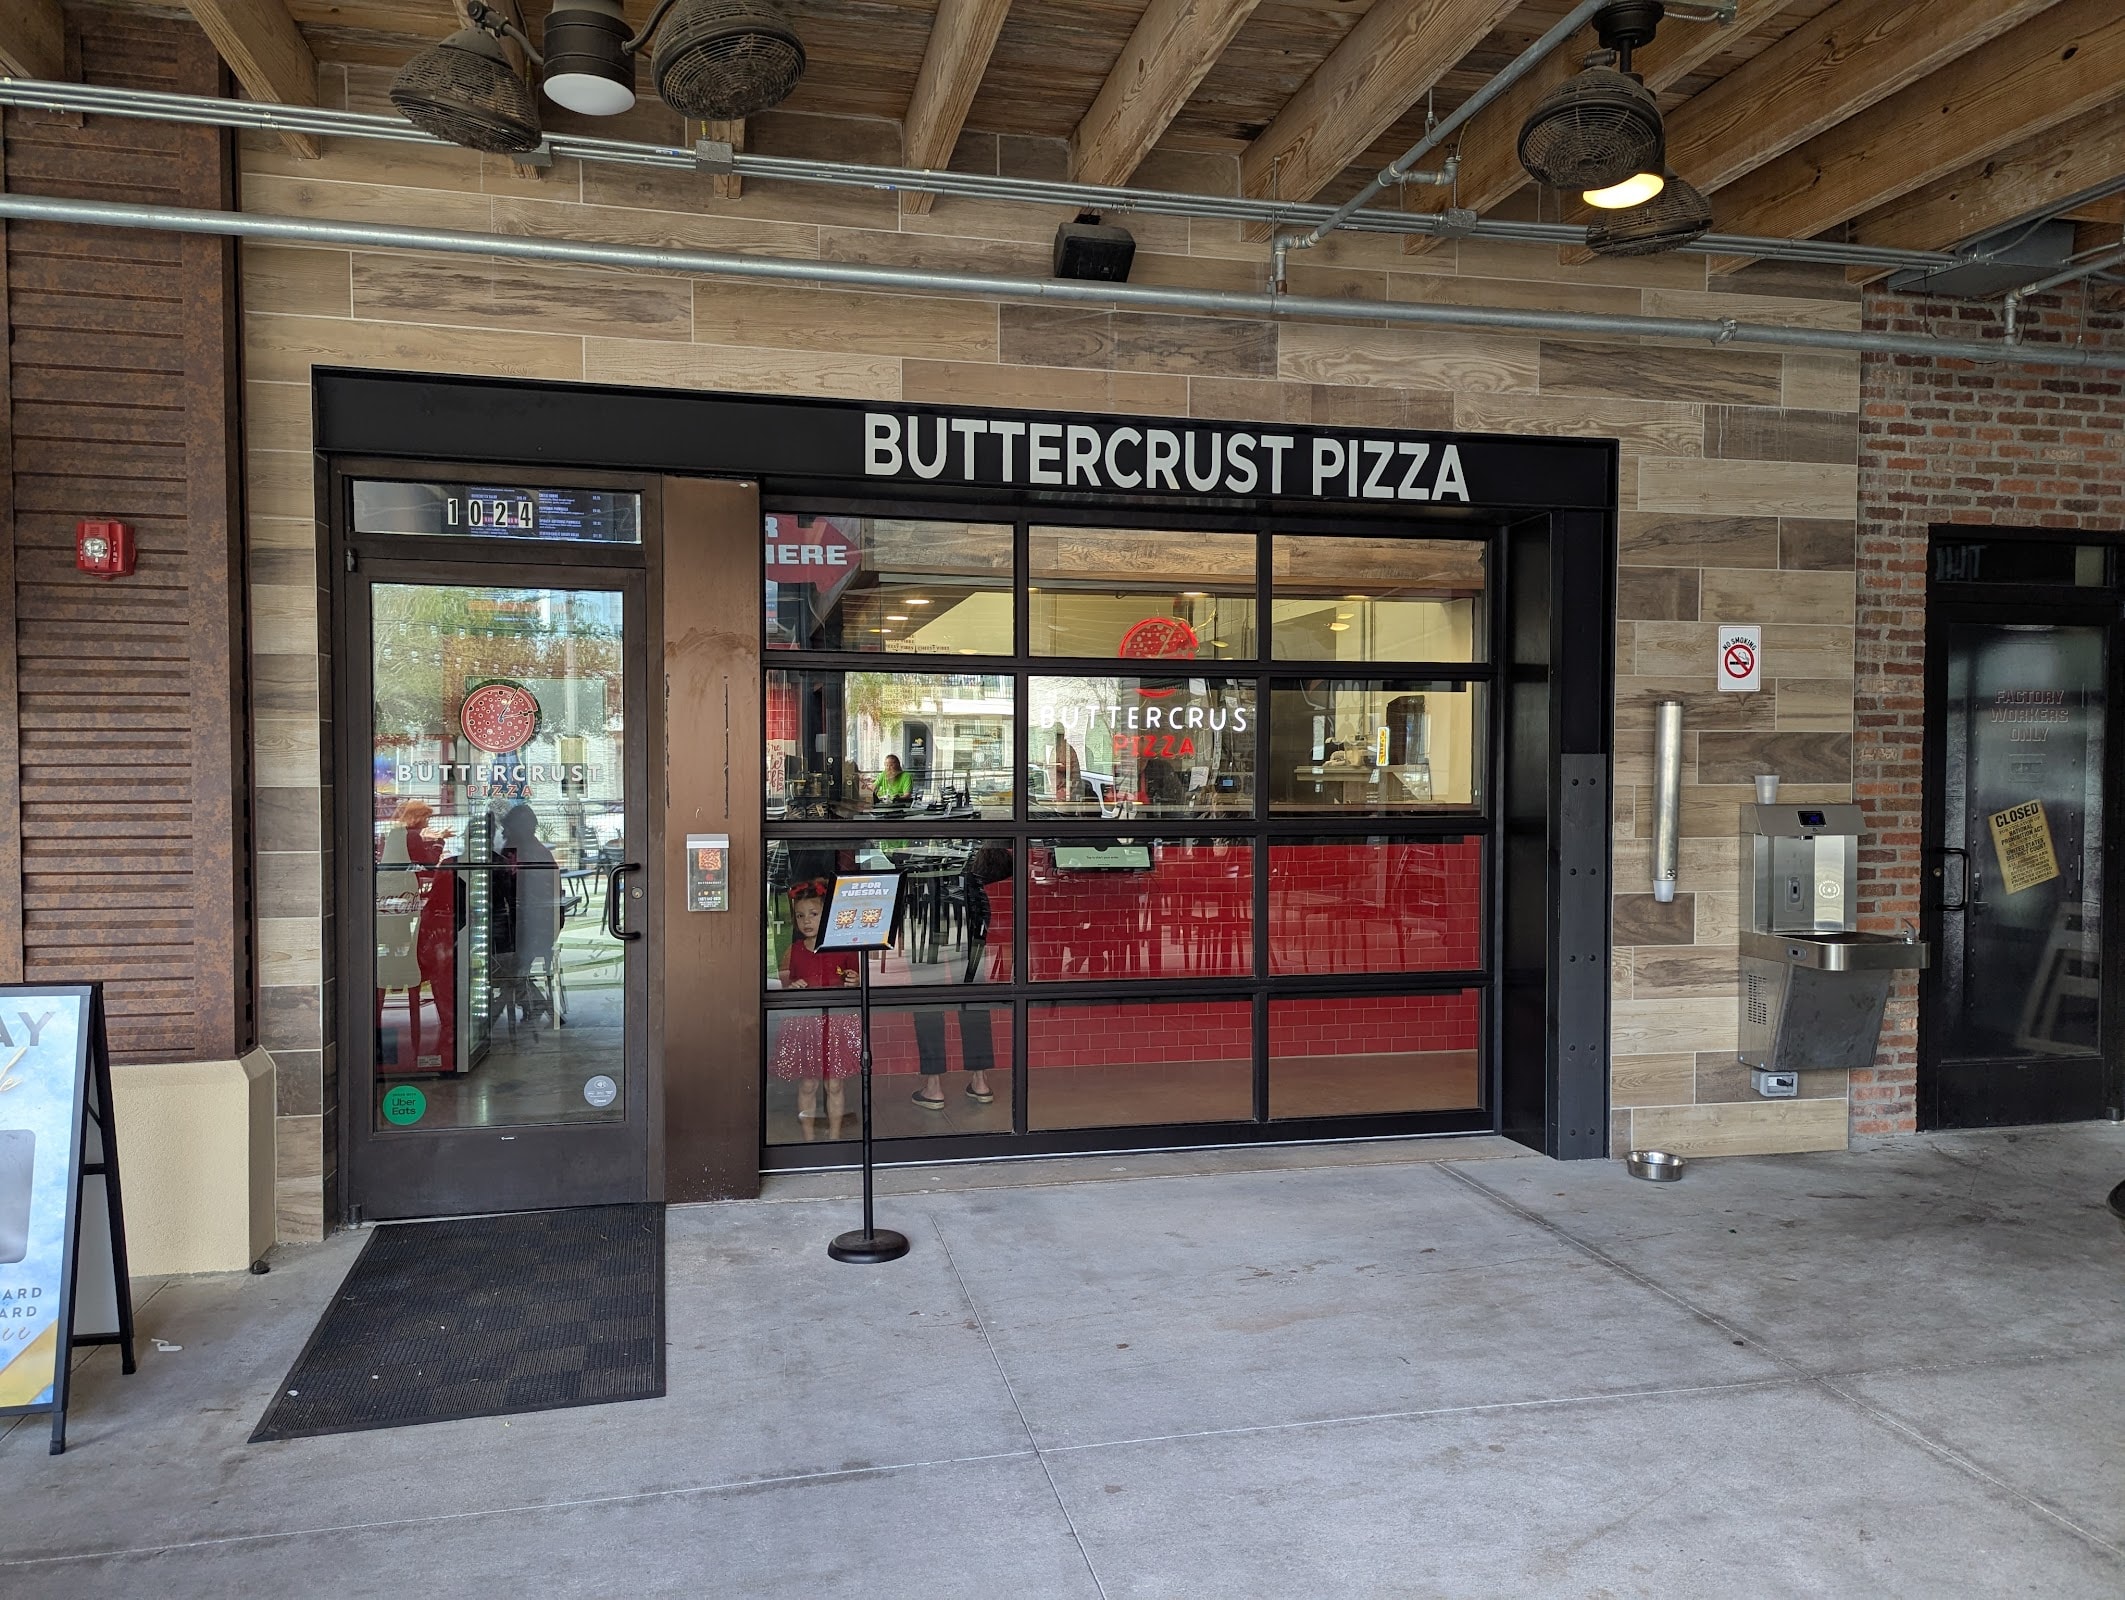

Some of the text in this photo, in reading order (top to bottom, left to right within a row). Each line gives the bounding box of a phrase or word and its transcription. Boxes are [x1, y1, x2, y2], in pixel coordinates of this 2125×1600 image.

[865, 413, 1470, 502] BUTTERCRUST PIZZA
[1722, 636, 1757, 651] NO SMOKING
[1995, 689, 2065, 705] FACTORY
[1040, 705, 1255, 732] BUTTERCRUS
[1991, 707, 2069, 723] WORKERS
[2010, 726, 2049, 742] ONLY
[1112, 733, 1196, 759] PIZZA
[397, 763, 601, 783] BUTTERCRUST
[467, 783, 534, 798] PIZZA
[1995, 803, 2039, 827] CLOSED
[2000, 825, 2043, 845] PROHIBITION ACT
[2008, 823, 2033, 836] NATIONAL
[2006, 837, 2044, 855] UNITED STATES
[2006, 842, 2046, 861] DISTRICT COURT
[841, 888, 890, 897] TUESDAY
[392, 1098, 417, 1107] Uber
[392, 1107, 416, 1116] Eats
